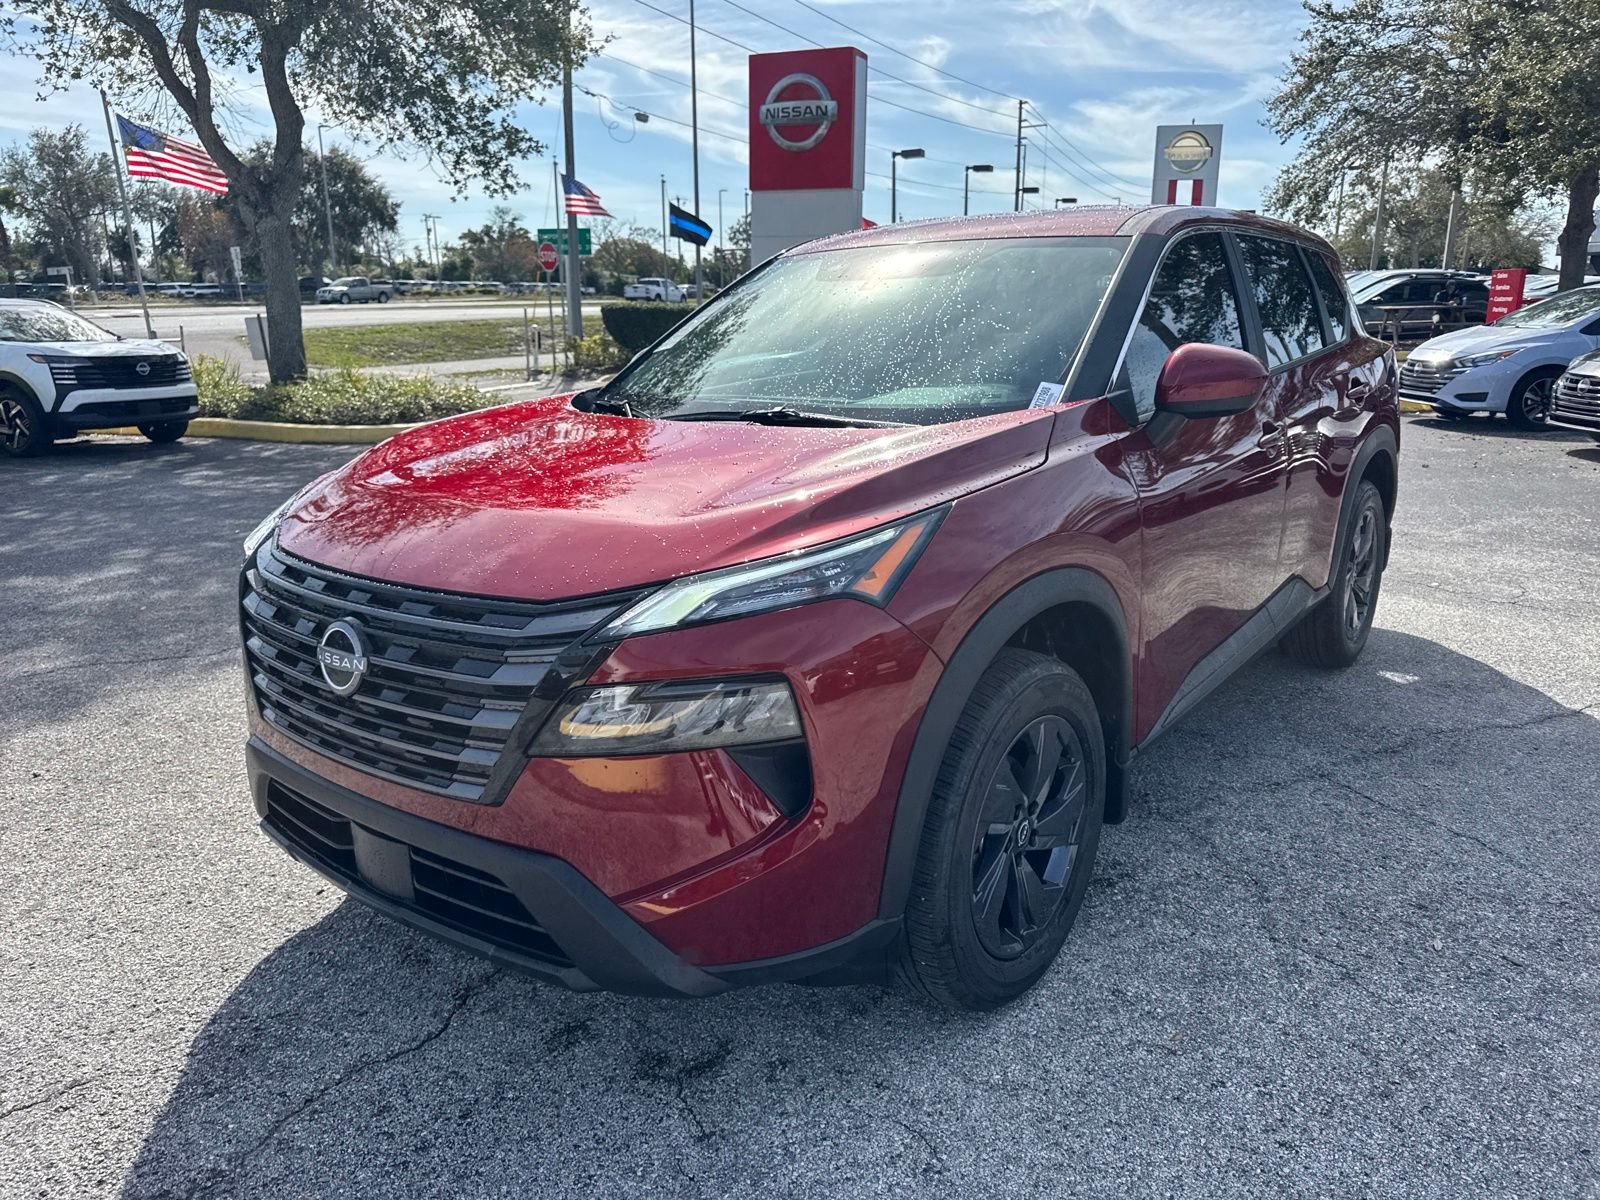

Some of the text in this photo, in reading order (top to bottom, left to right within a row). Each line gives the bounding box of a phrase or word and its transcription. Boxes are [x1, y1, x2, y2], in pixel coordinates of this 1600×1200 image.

[765, 105, 828, 119] NISSAN
[540, 250, 557, 262] STOP
[1491, 306, 1508, 314] Parking
